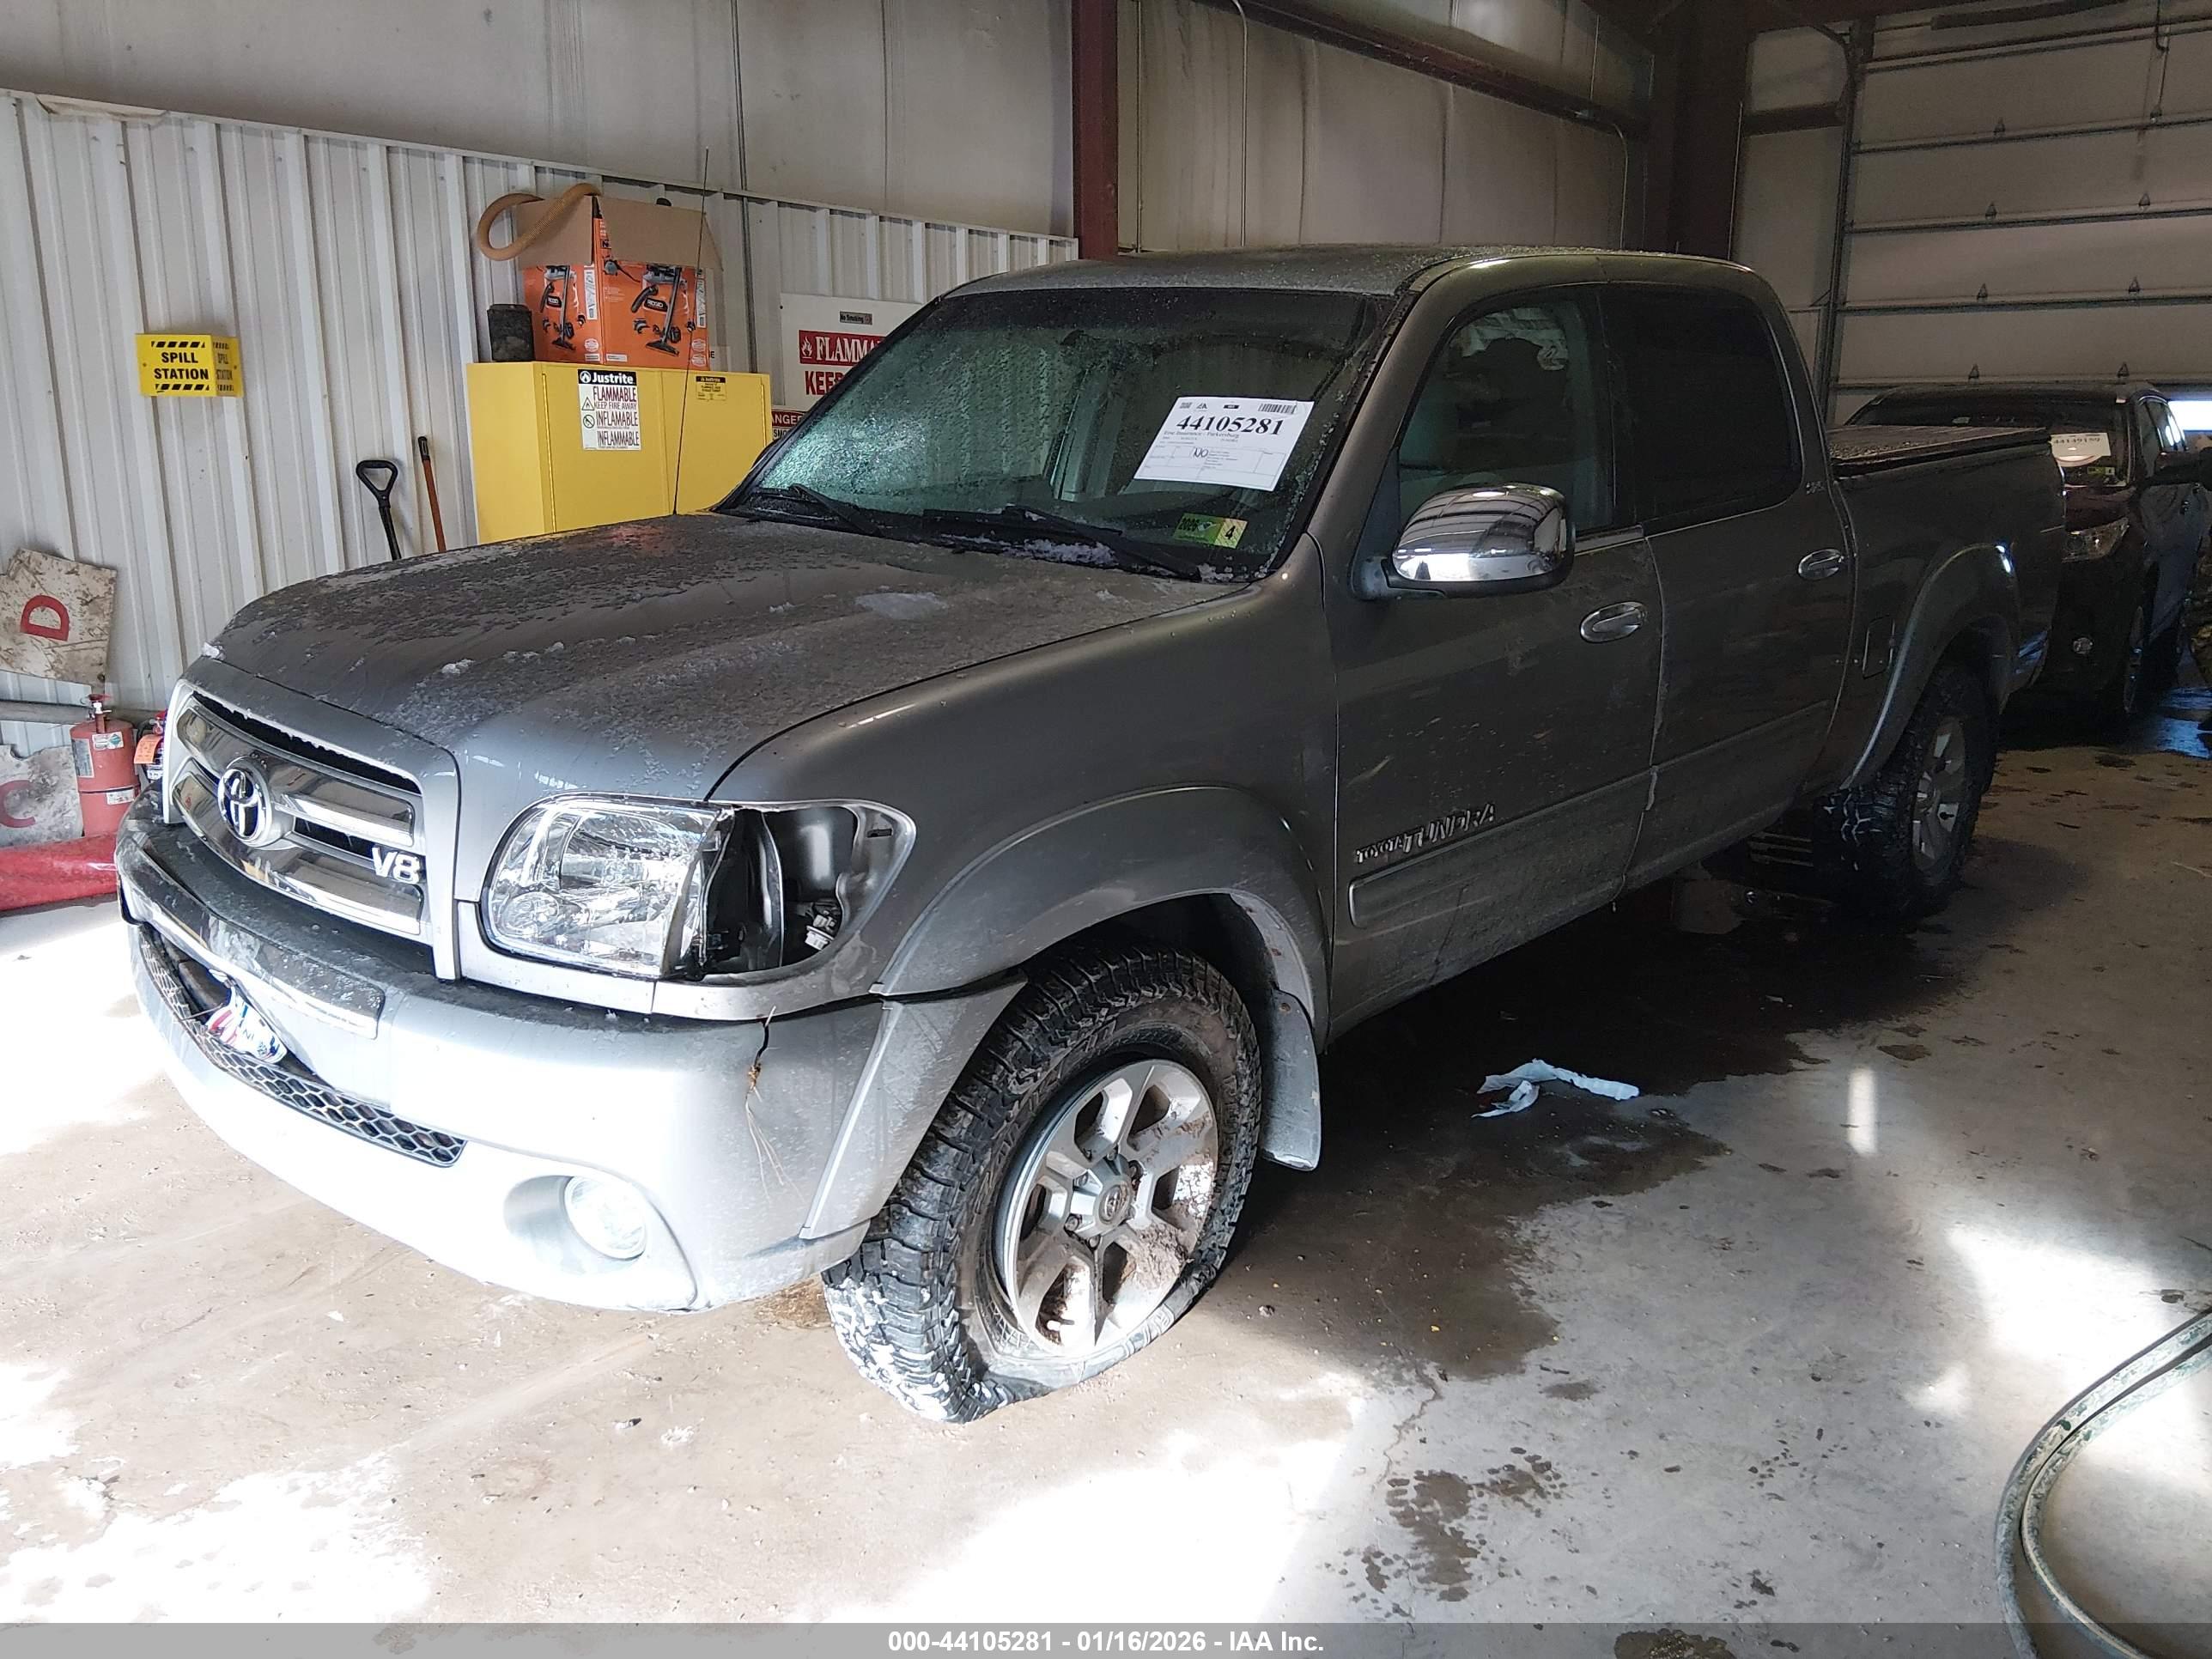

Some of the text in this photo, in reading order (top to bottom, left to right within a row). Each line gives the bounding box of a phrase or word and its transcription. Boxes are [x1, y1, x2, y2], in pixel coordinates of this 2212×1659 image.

[815, 336, 881, 362] FLAMM
[161, 352, 198, 363] SPILL
[154, 368, 209, 380] STATION
[592, 373, 634, 384] Justrite
[592, 386, 637, 402] FLAMMABLE
[596, 411, 638, 426] INFLAMABLE
[1176, 416, 1284, 435] 44105281
[597, 430, 639, 446] INFLAMMABLE
[1224, 525, 1236, 540] 4
[21, 594, 70, 642] D
[0, 779, 36, 829] C
[1402, 802, 1497, 853] TUNDRA
[372, 846, 420, 885] V8
